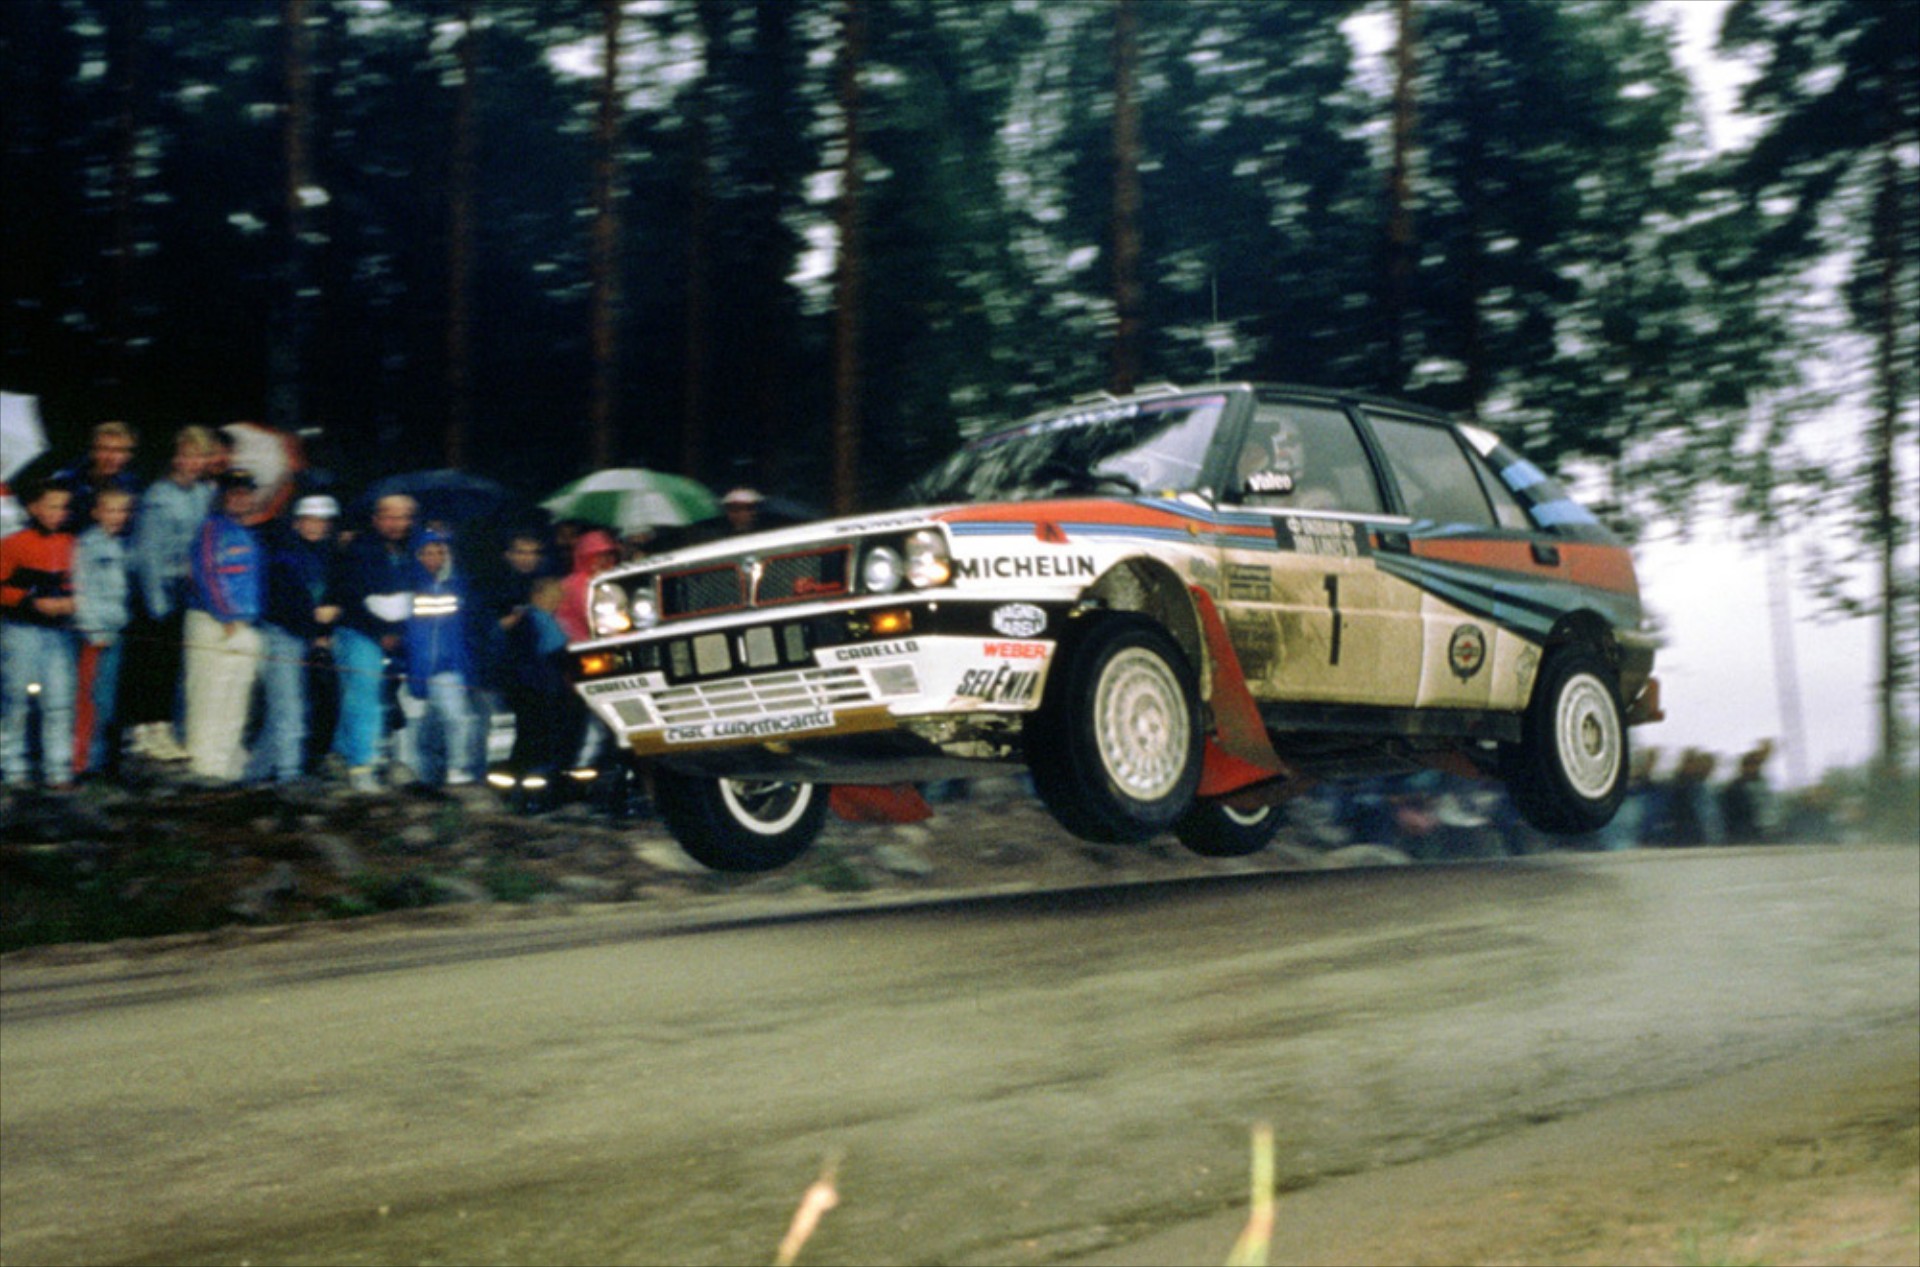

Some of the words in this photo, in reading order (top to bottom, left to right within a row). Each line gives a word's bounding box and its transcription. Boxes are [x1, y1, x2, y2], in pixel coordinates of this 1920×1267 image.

[952, 555, 1095, 578] MICHELIN
[1323, 574, 1341, 667] 1
[835, 640, 919, 661] CARELLO
[983, 642, 1046, 658] WEBER
